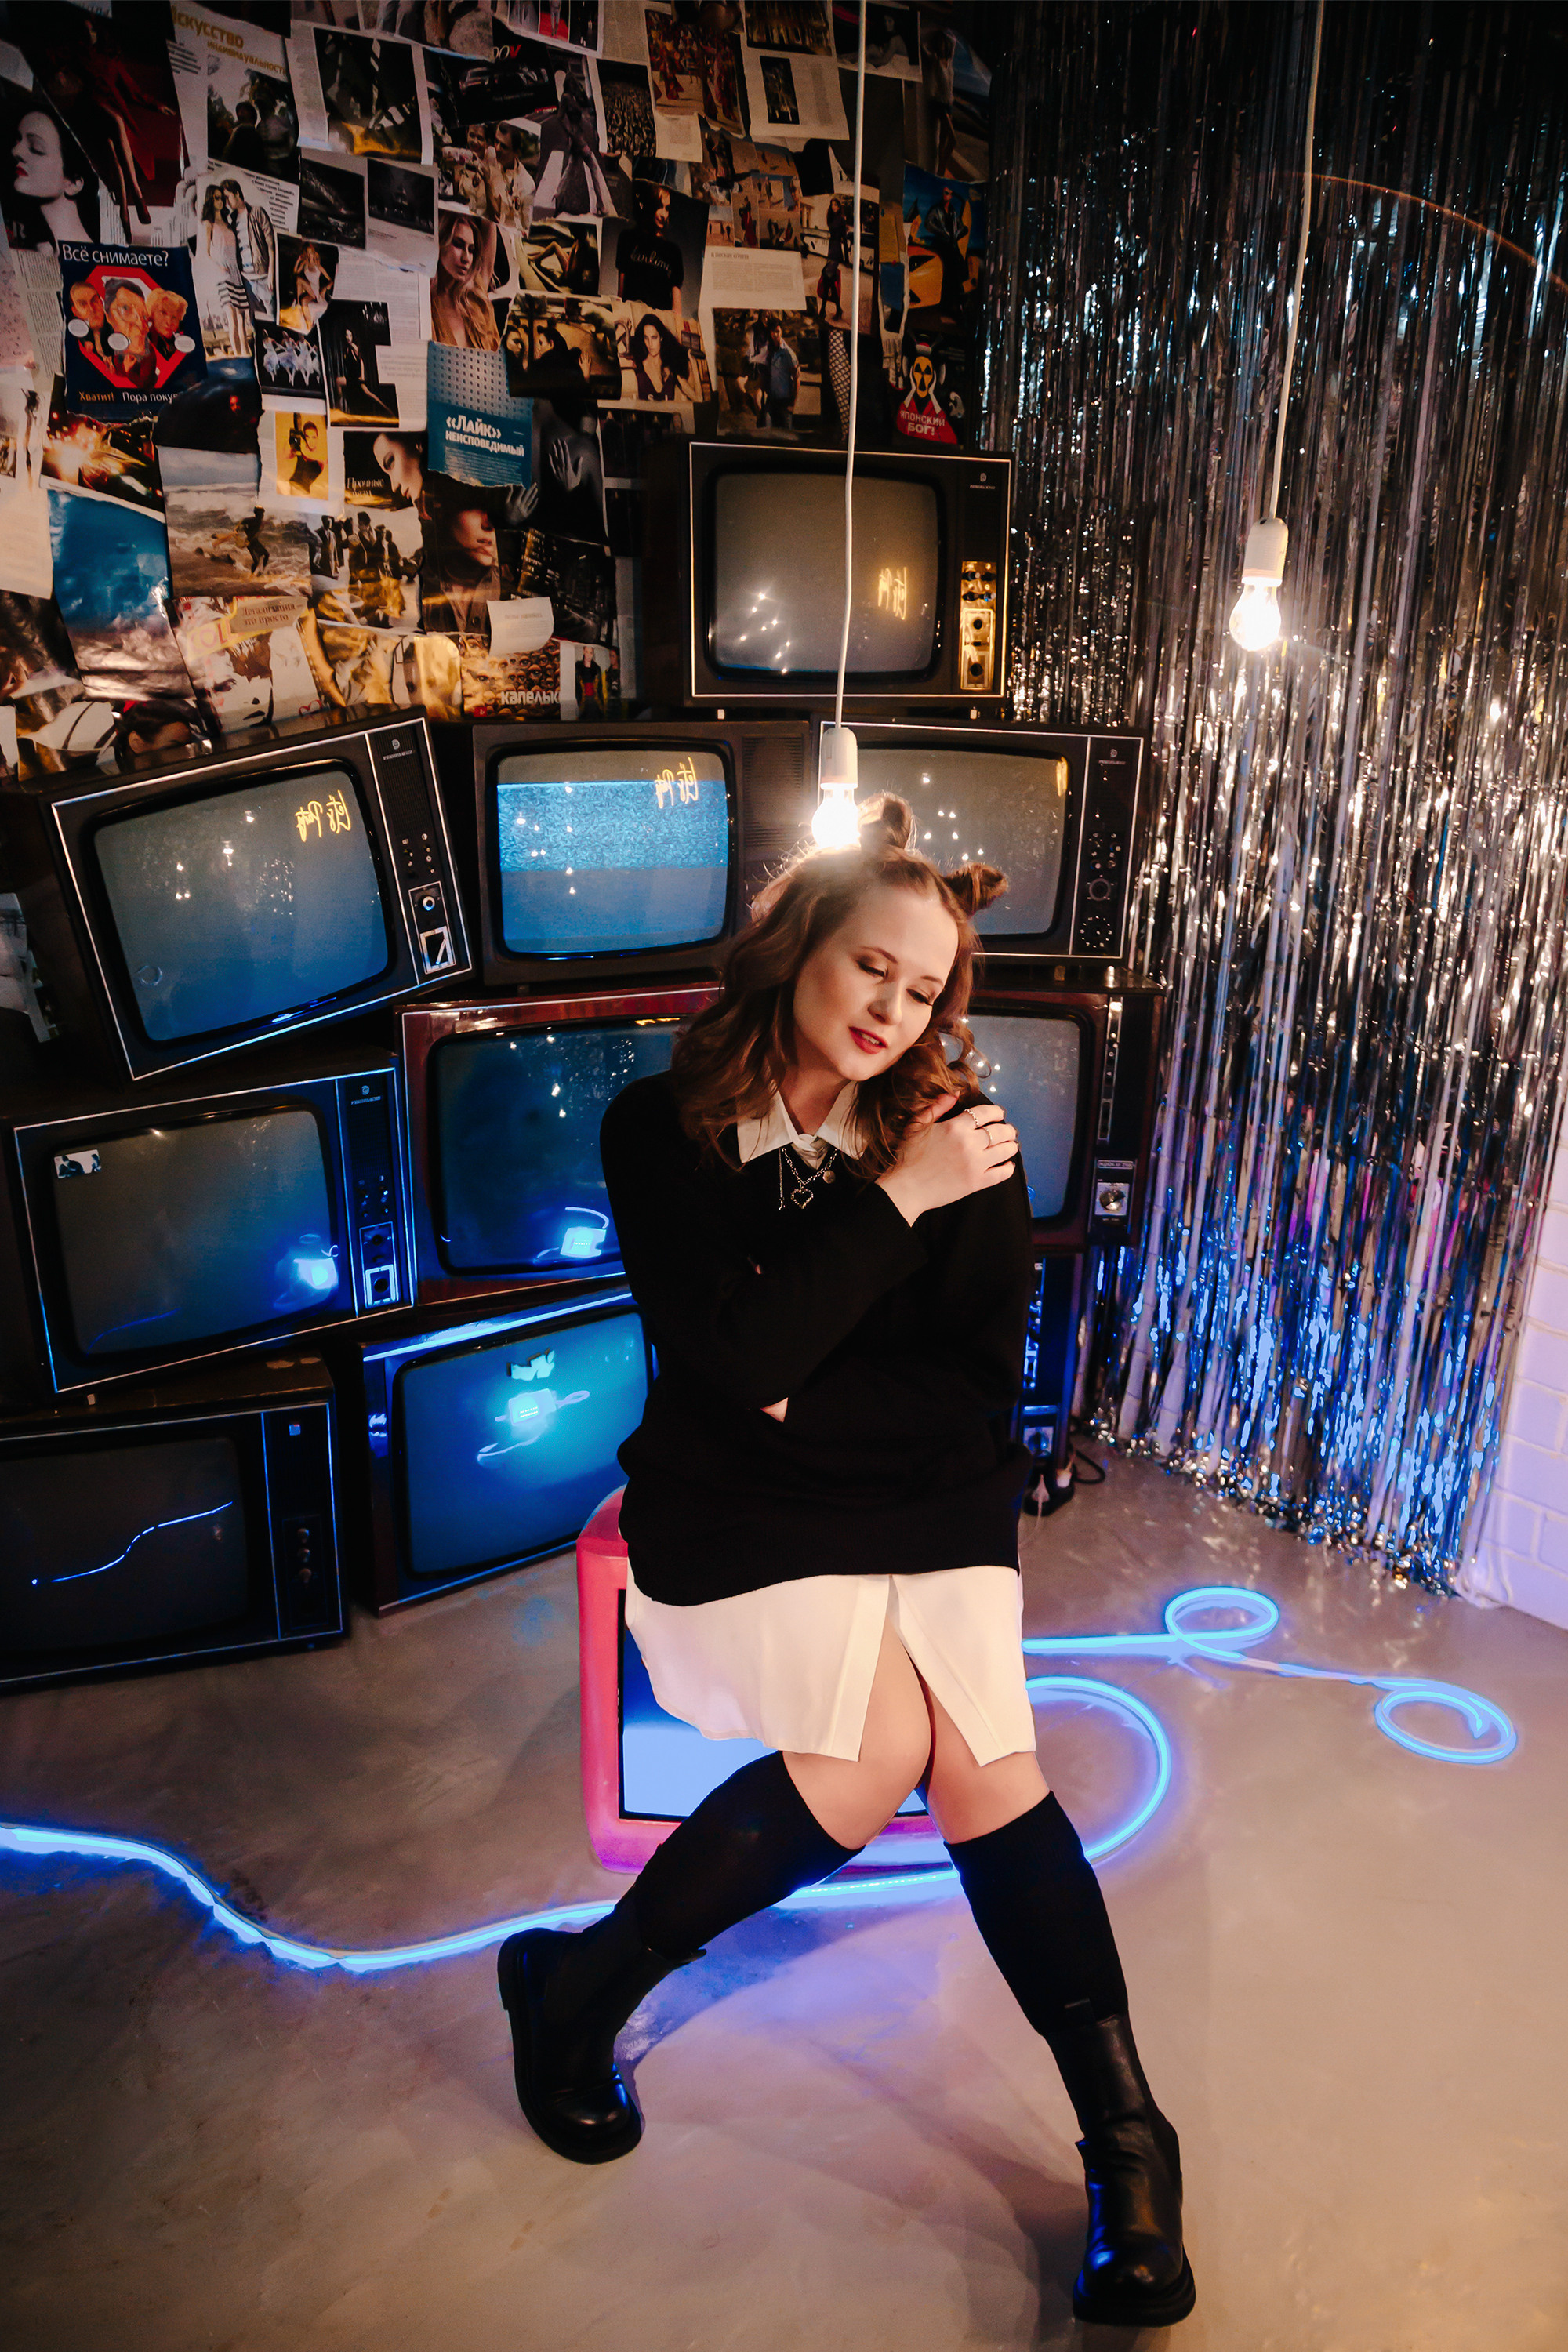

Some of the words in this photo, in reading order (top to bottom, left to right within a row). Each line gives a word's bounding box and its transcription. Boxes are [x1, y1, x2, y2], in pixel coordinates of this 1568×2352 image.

[62, 244, 89, 263] Всё
[92, 249, 169, 267] снимаете?
[78, 391, 114, 402] Хватит!
[122, 391, 147, 405] Пора
[907, 422, 935, 436] БОГ!
